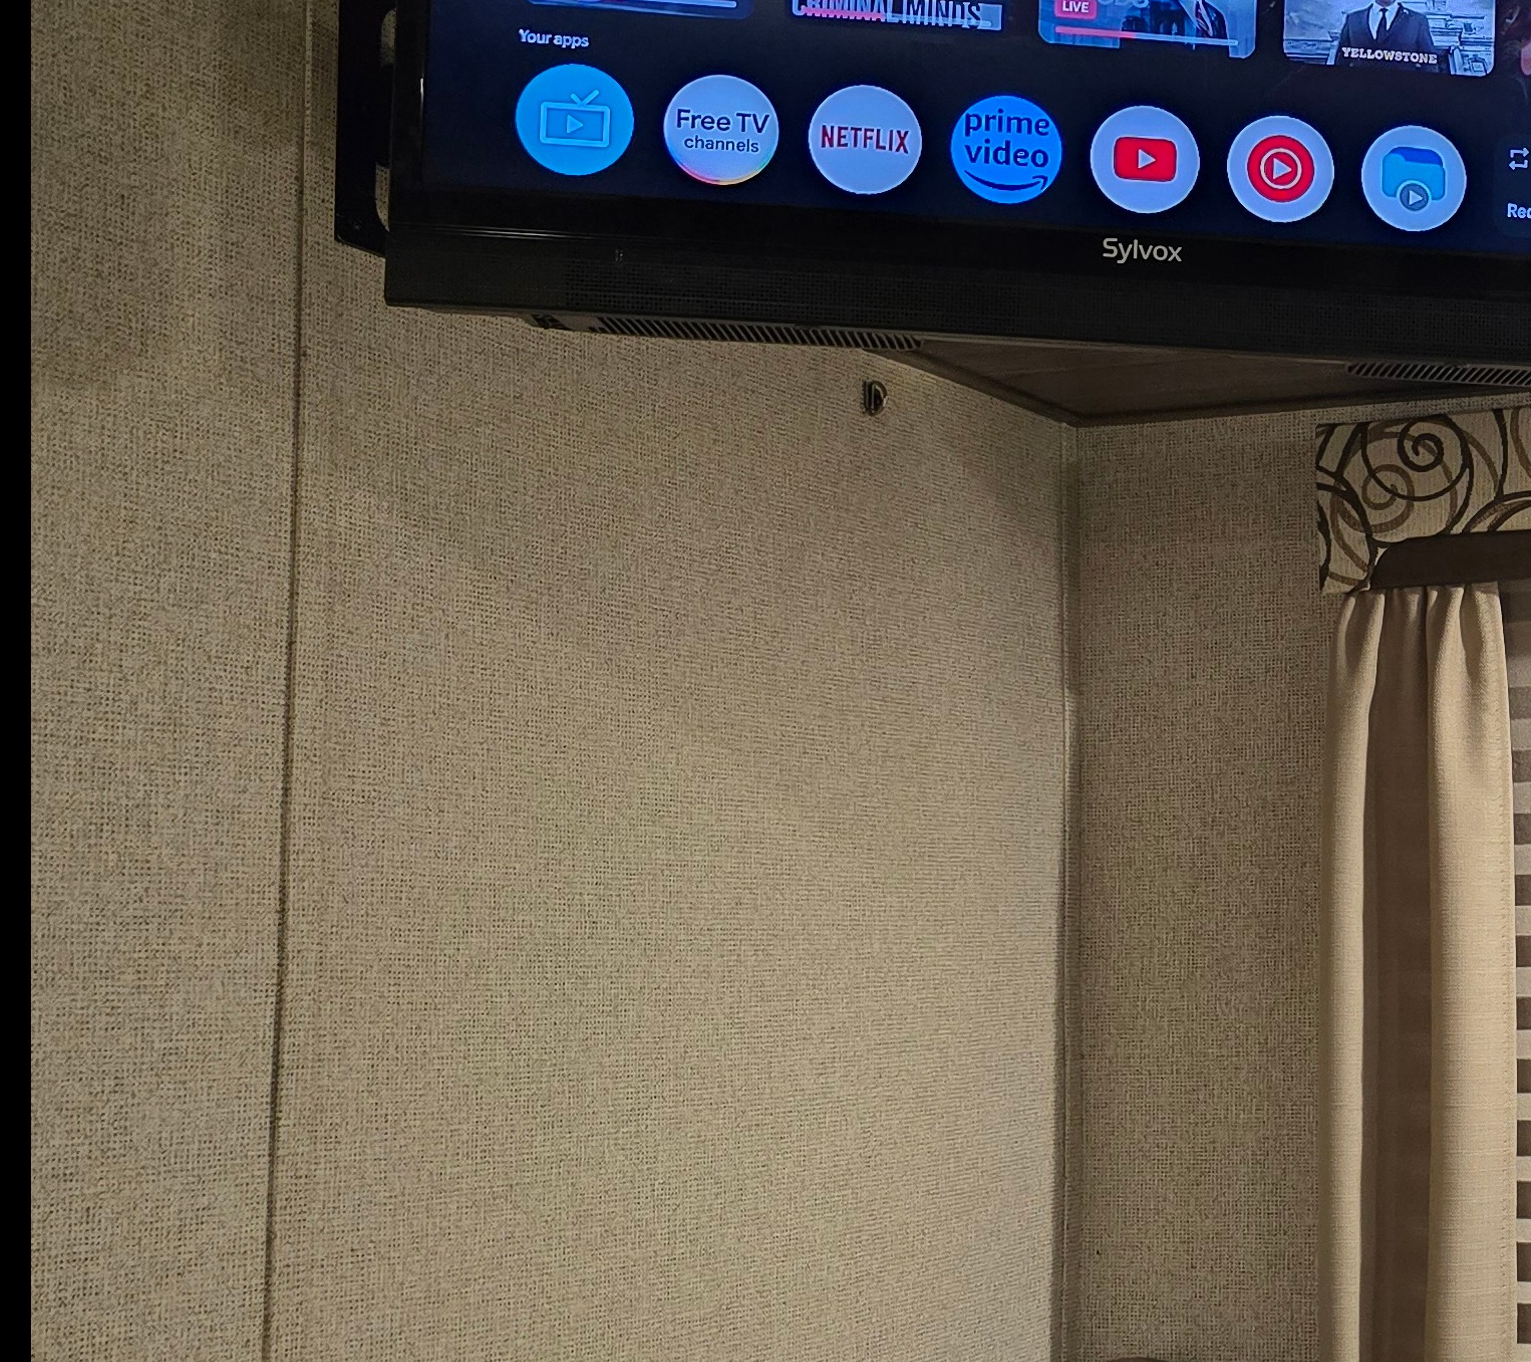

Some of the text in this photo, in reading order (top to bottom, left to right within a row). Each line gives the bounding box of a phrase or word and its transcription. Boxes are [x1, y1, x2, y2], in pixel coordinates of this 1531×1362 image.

[1061, 0, 1090, 14] LIVE
[518, 28, 590, 49] Your apps
[1340, 45, 1438, 66] YELLOWSTONE
[674, 108, 771, 135] Free TV
[965, 110, 1051, 140] prime
[683, 134, 760, 154] channels
[820, 124, 910, 155] NETFLIX
[963, 141, 1050, 169] video
[1102, 237, 1183, 265] Sylvox
